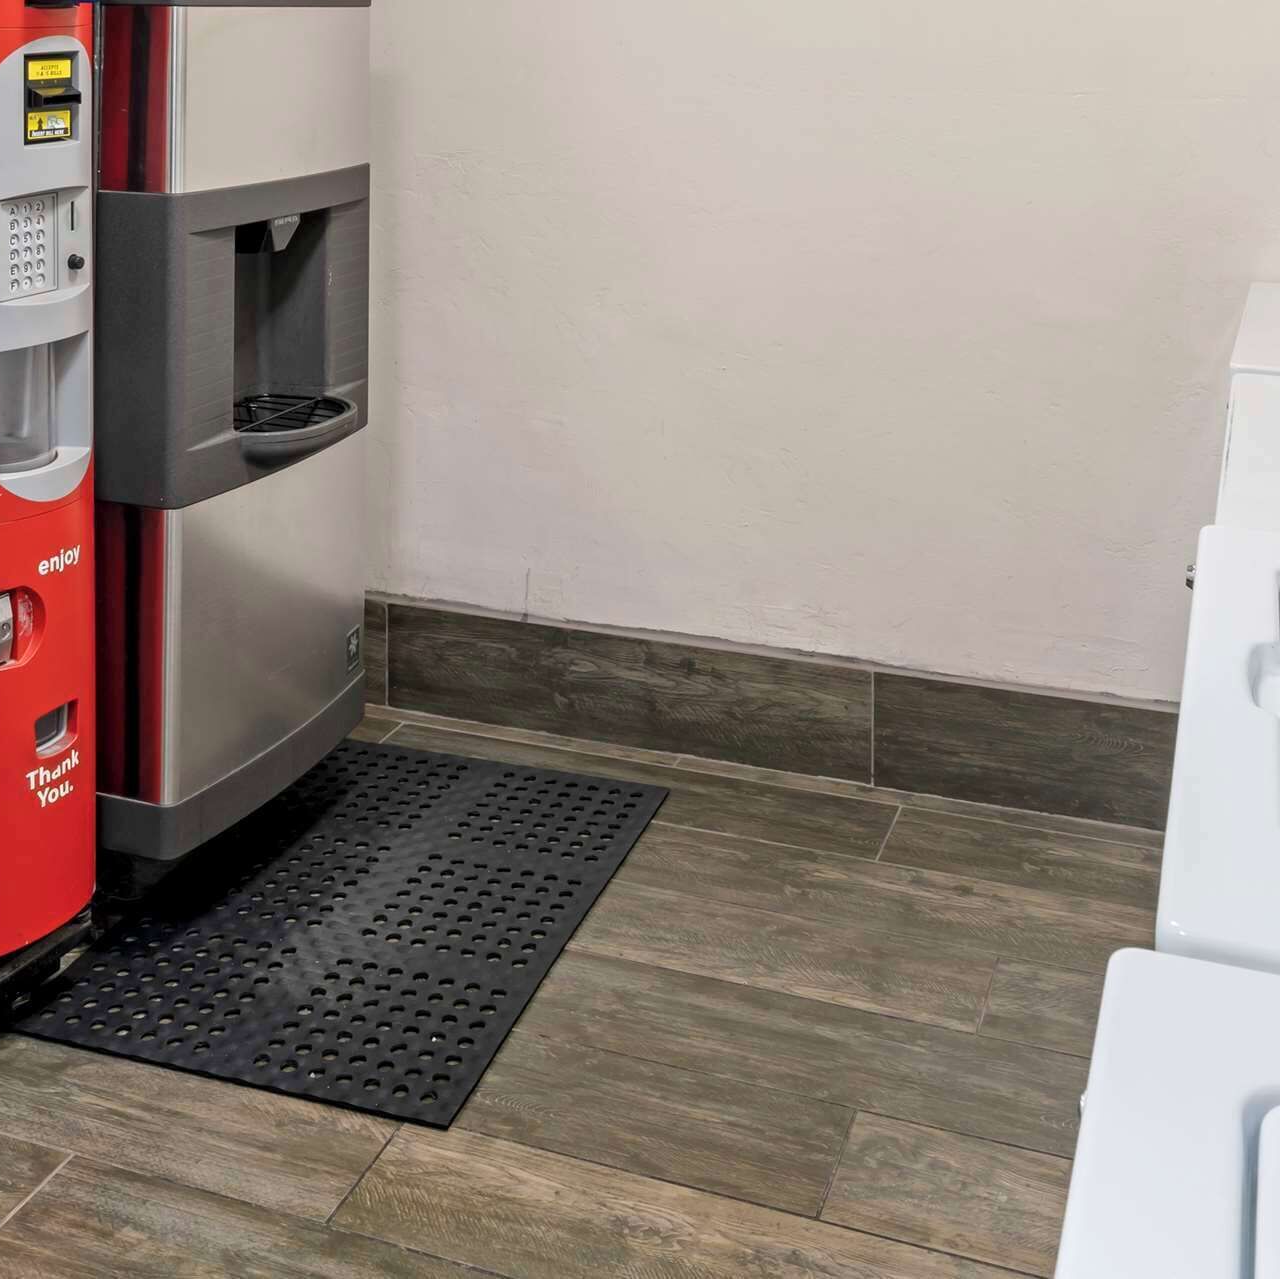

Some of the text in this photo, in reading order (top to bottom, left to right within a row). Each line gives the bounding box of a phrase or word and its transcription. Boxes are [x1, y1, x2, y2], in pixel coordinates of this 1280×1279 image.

[38, 545, 81, 575] enjoy
[26, 749, 79, 790] Thank
[37, 778, 74, 809] You.
